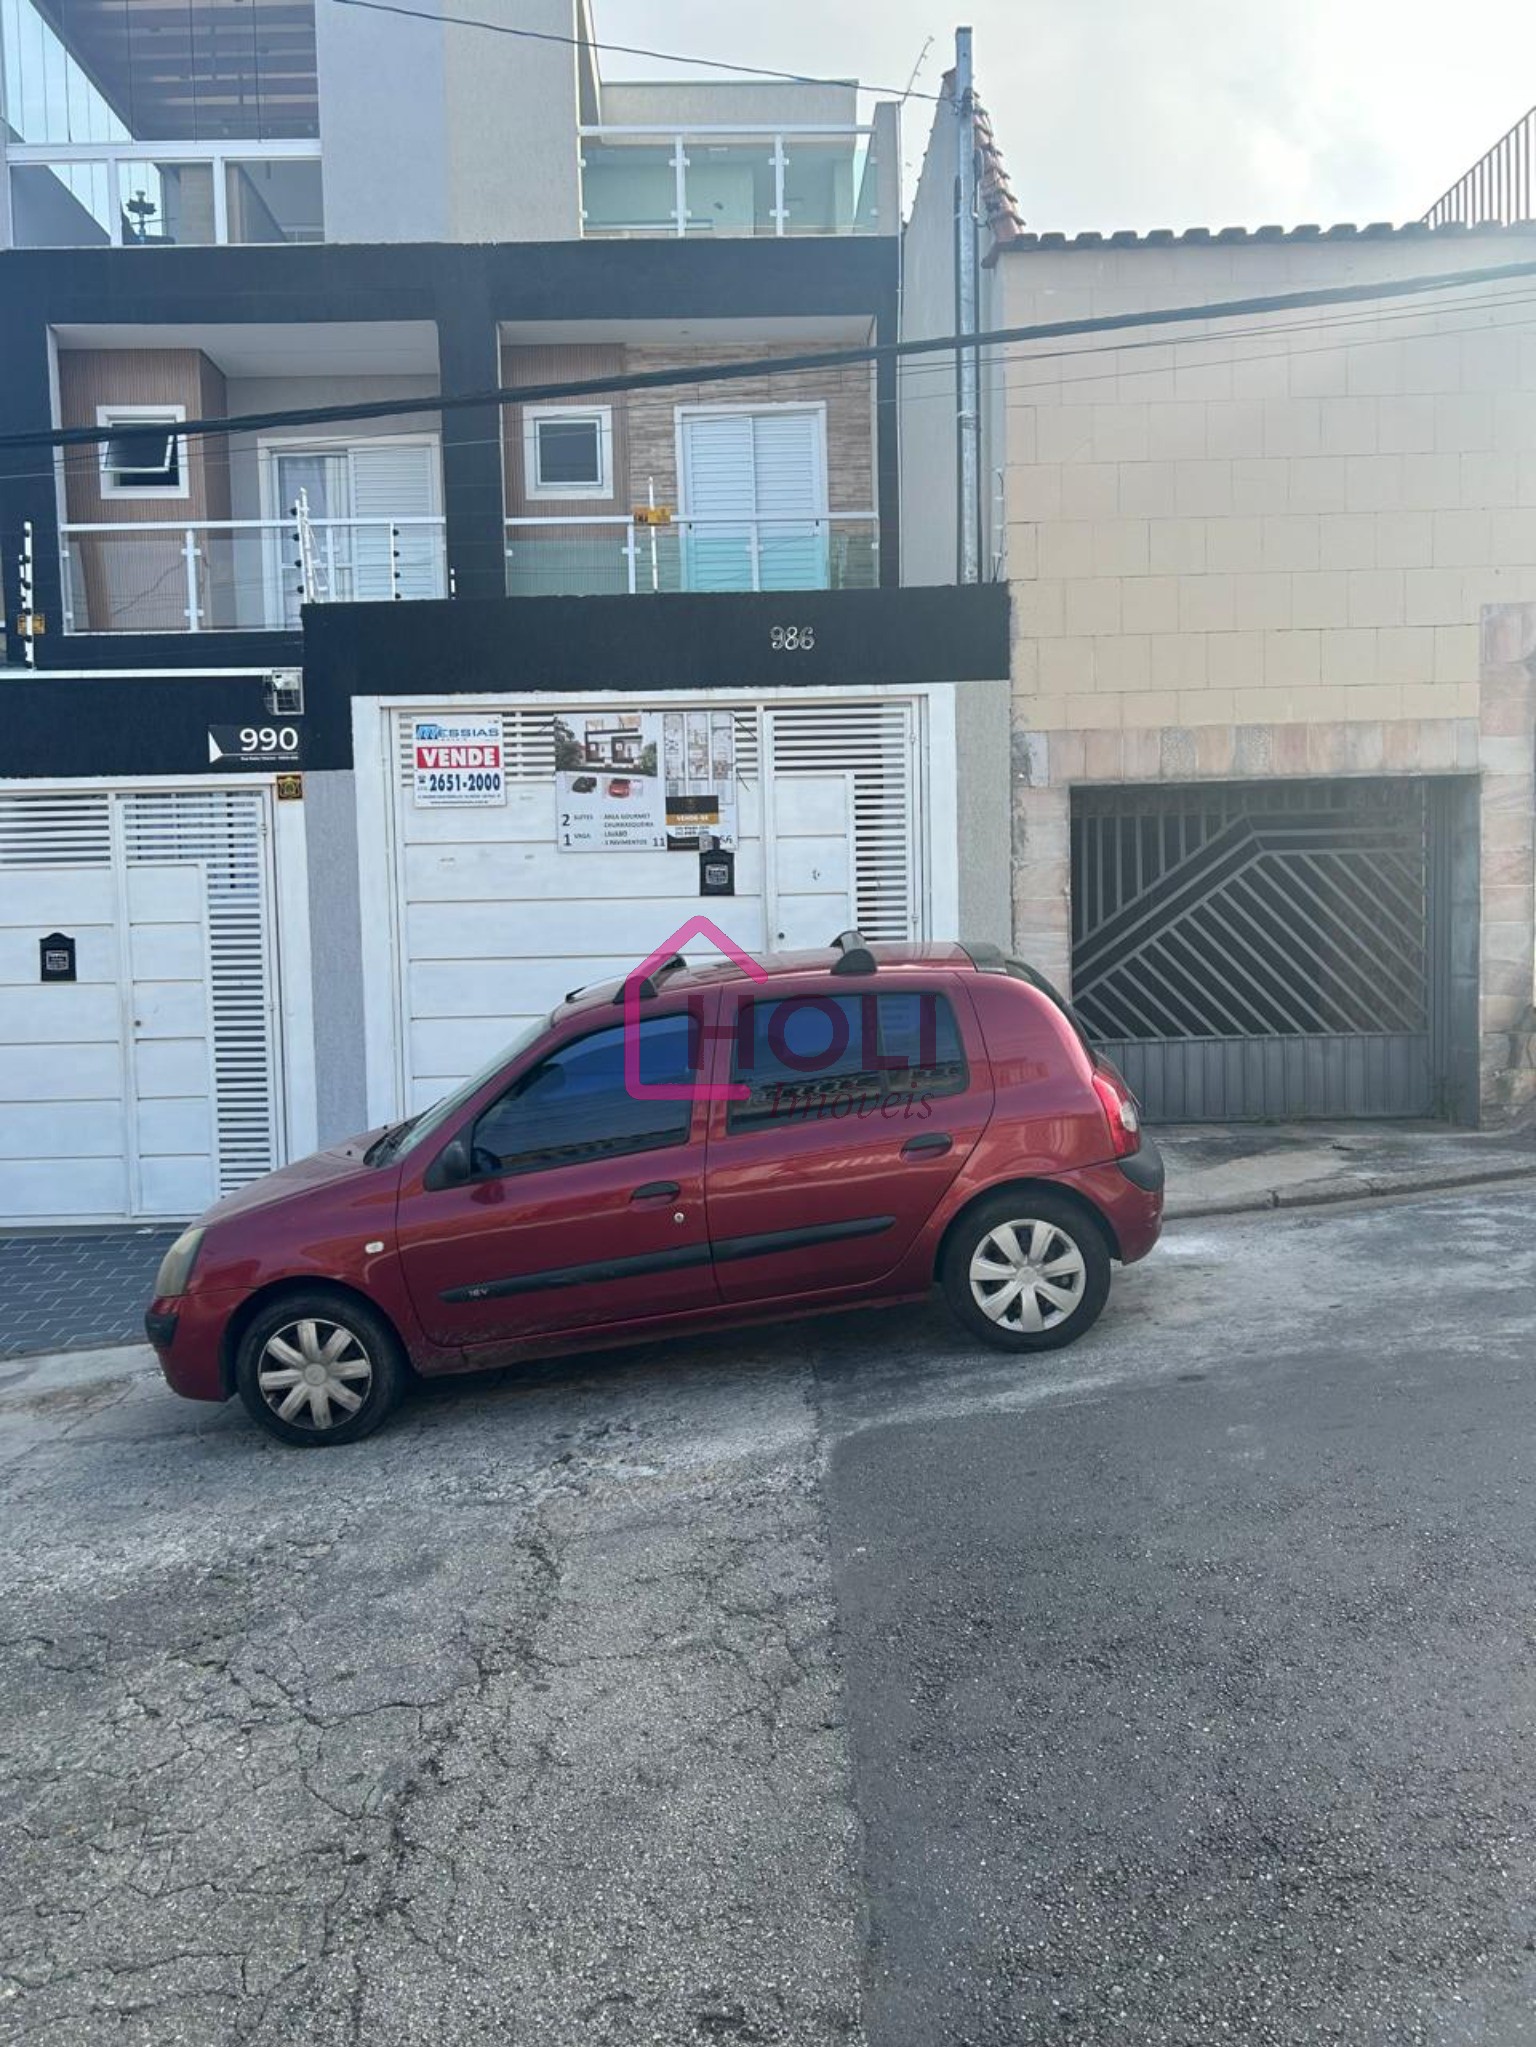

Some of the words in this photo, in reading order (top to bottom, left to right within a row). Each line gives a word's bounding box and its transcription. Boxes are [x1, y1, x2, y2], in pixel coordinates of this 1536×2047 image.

[770, 626, 815, 650] 986
[240, 727, 299, 751] 990
[421, 746, 496, 767] VENDE
[562, 814, 571, 827] 2
[564, 833, 572, 846] 1
